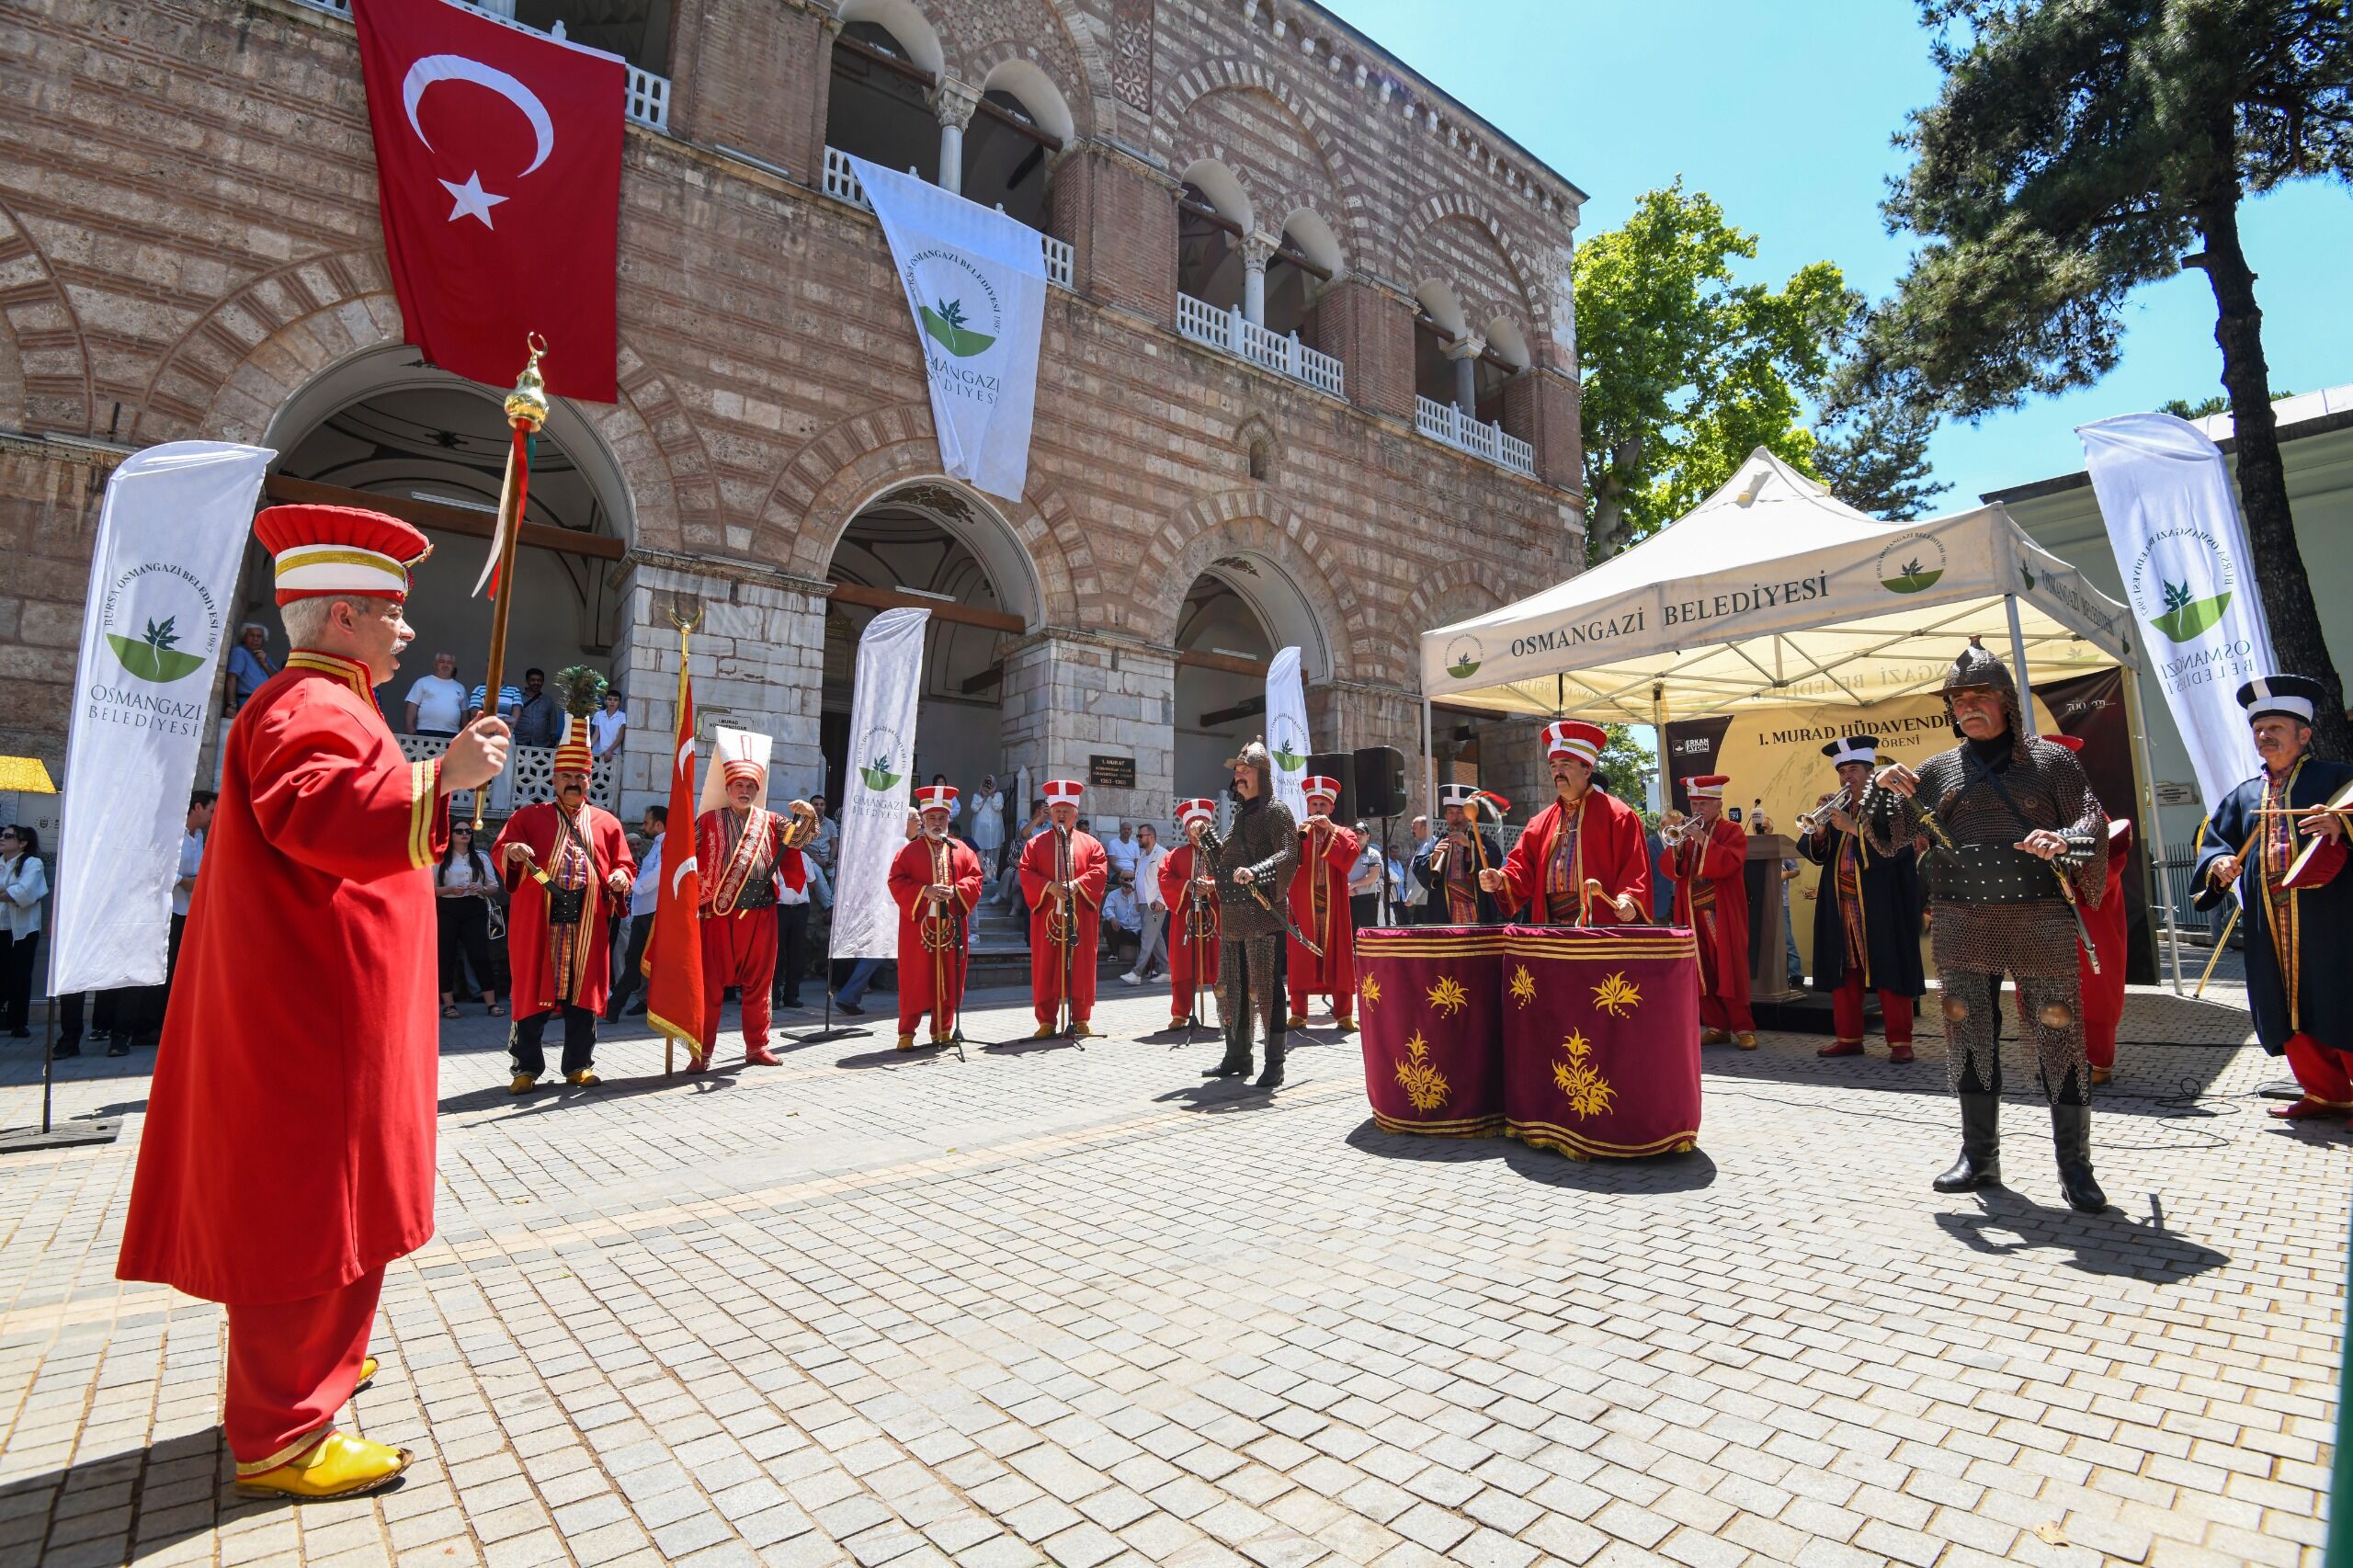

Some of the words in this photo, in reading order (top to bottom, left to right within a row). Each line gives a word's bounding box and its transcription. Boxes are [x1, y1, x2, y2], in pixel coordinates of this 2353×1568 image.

[960, 258, 1001, 313] BELEDİYESİ
[993, 314, 1001, 335] 1987
[104, 589, 120, 626] BURSA
[117, 562, 182, 589] OSMANGAZİ
[182, 570, 221, 629] BELEDİYESİ
[205, 632, 217, 653] 1987
[1510, 606, 1646, 657] OSMANGAZİ
[1663, 569, 1830, 627] BELEDİYESİ
[90, 684, 202, 721] OSMANGAZİ
[88, 705, 199, 737] BELEDİYESİ
[1759, 733, 1769, 745] I.
[1772, 726, 1836, 744] MURAD
[1840, 710, 1950, 738] HÜDAVENDİ
[1686, 737, 1709, 745] ERKAN
[1687, 744, 1709, 752] AYDIN
